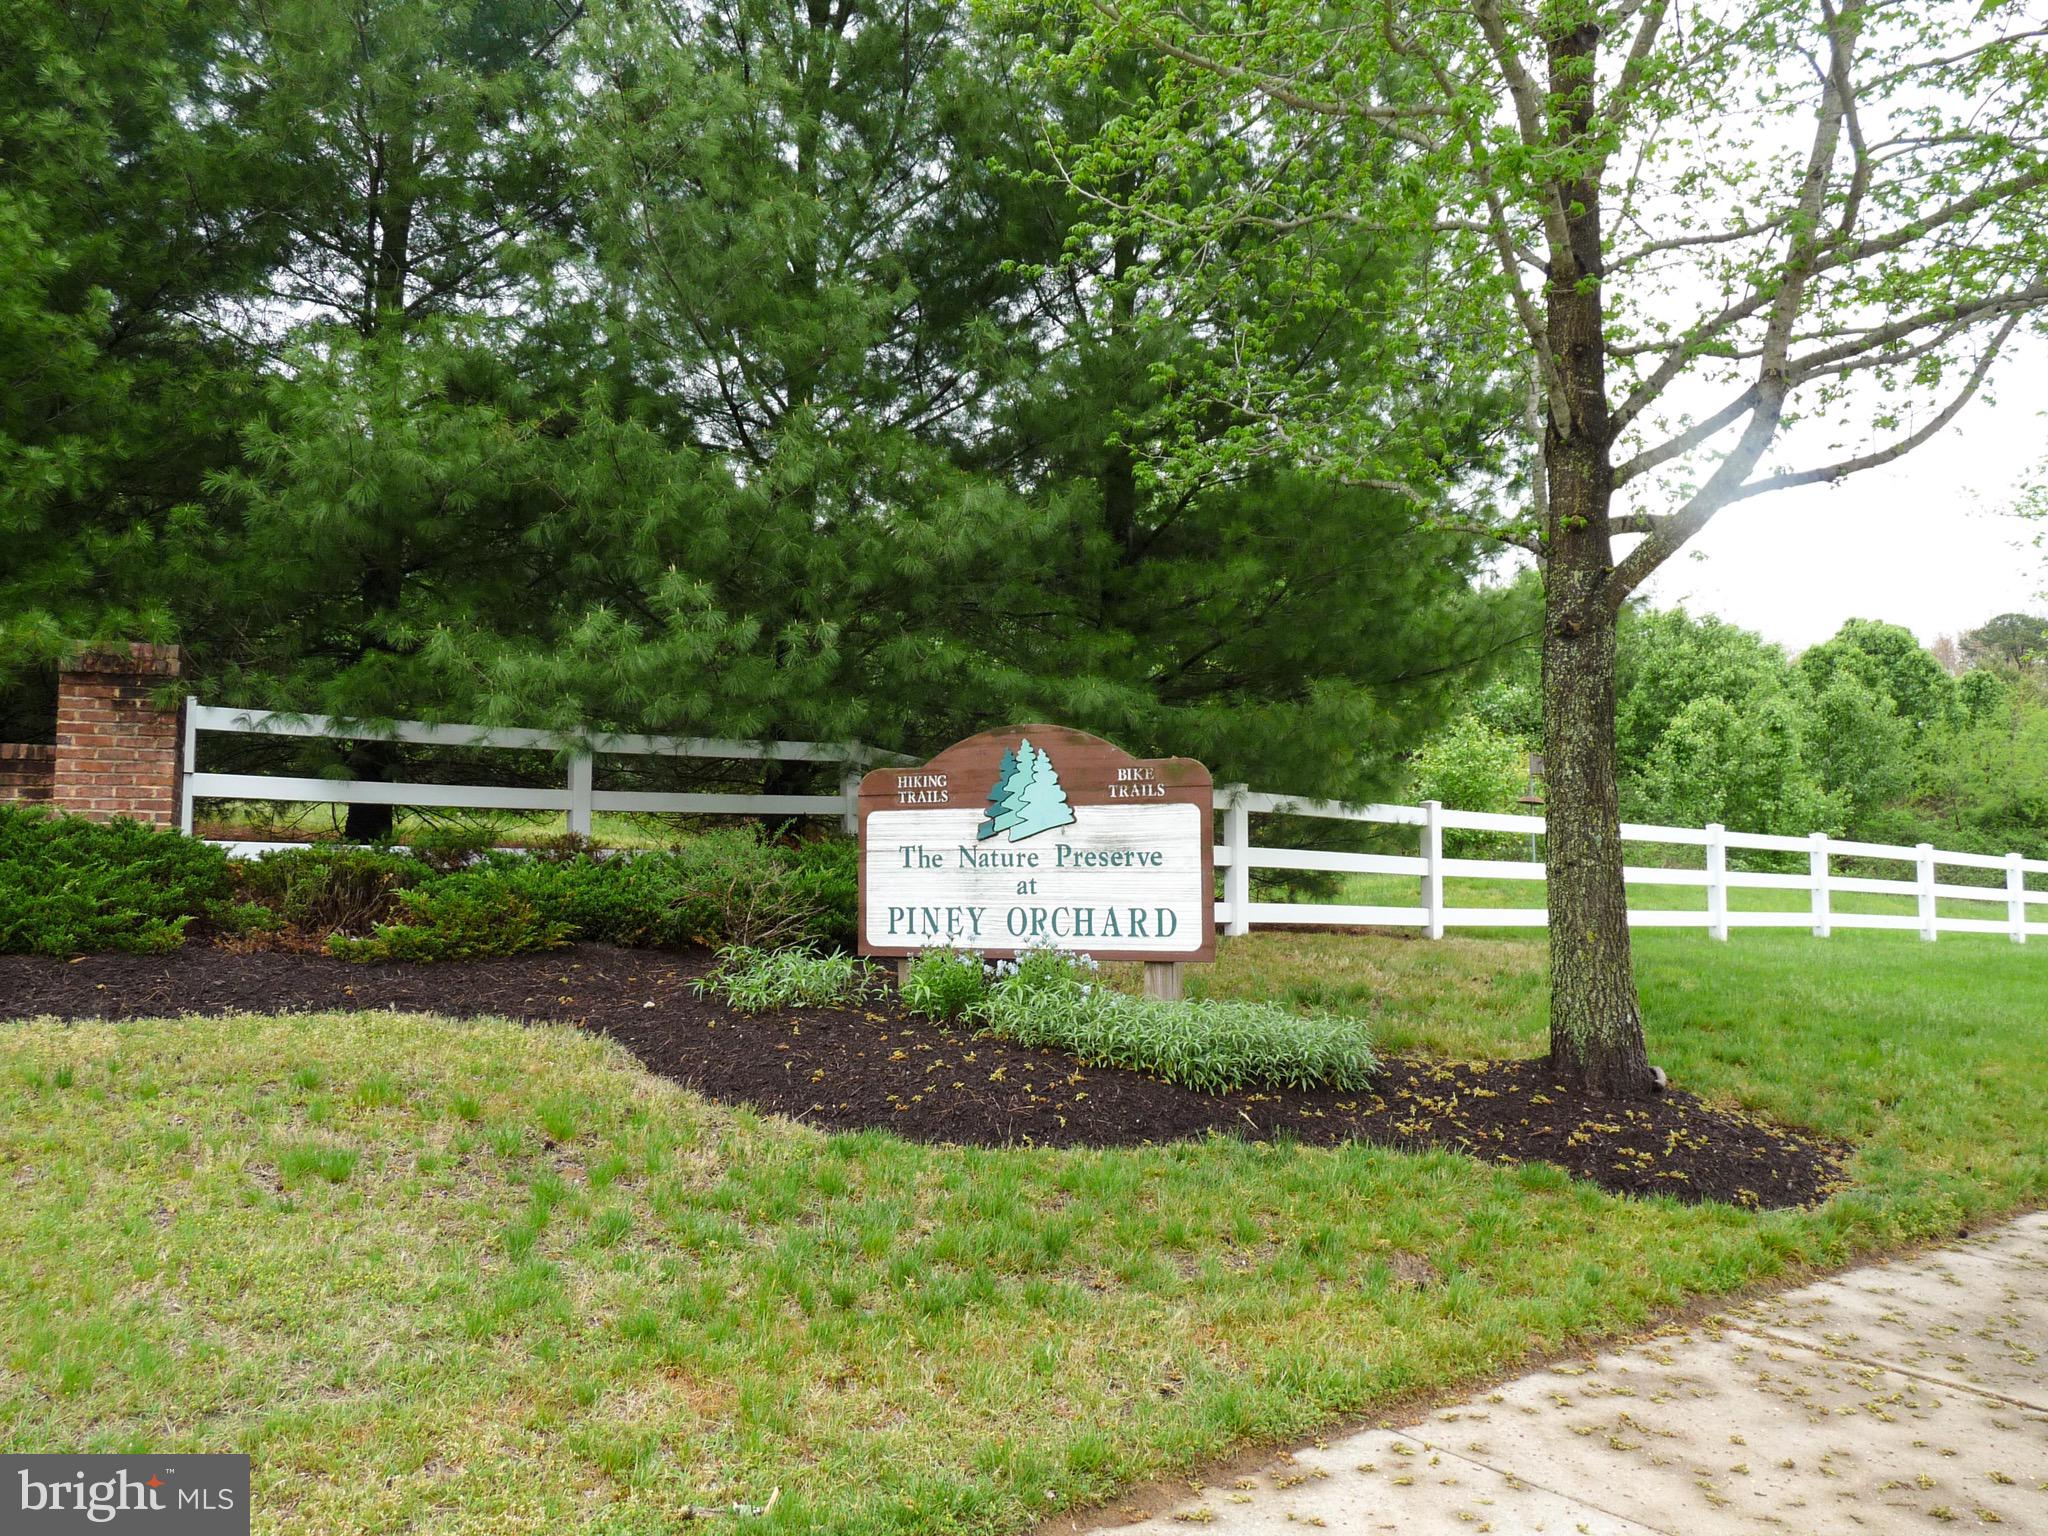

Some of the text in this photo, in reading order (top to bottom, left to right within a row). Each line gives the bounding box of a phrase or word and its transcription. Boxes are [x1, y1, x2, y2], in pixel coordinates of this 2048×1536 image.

[897, 774, 948, 788] HIKING
[1117, 767, 1155, 781] BIKE
[898, 790, 949, 804] TRAILS
[1108, 783, 1166, 798] TRAILS
[899, 843, 1163, 868] The Nature Preserve
[1016, 877, 1038, 895] at
[887, 906, 1178, 938] PINEY ORCHARD
